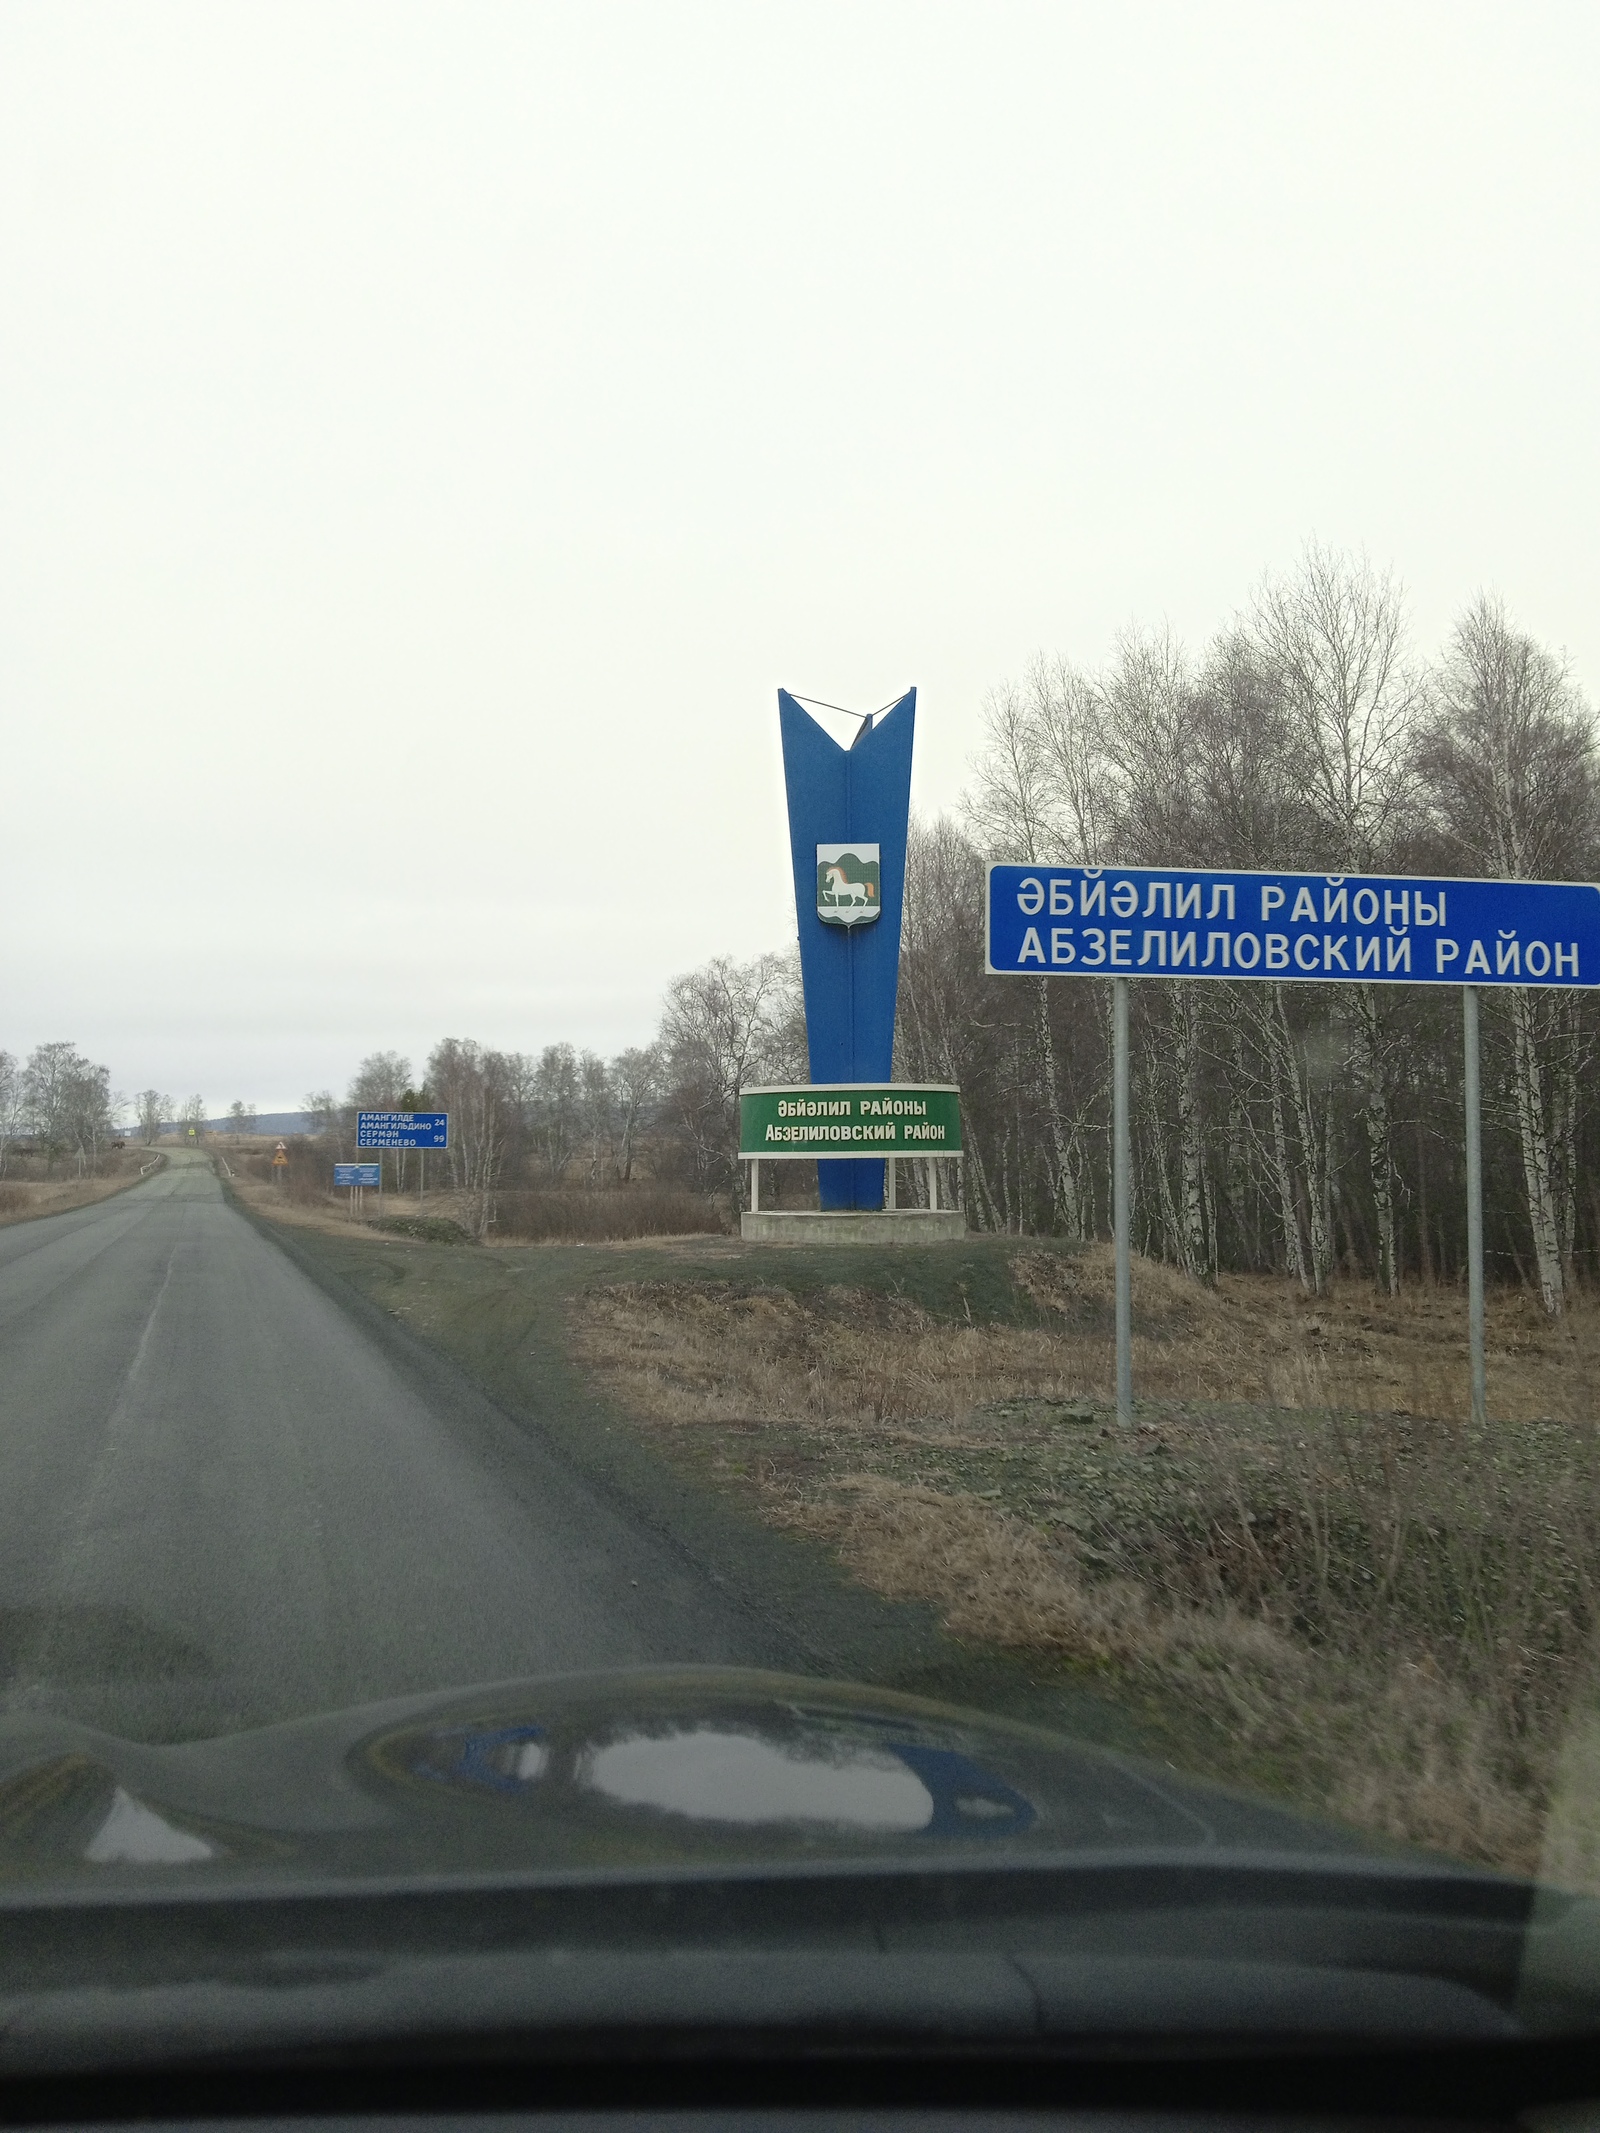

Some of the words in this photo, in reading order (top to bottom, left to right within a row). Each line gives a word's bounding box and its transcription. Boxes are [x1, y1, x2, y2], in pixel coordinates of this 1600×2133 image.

[1017, 869, 1235, 920] ӘБЙӘЛИЛ
[1261, 877, 1446, 927] РАЙОНЫ
[1017, 926, 1411, 972] АБЗЕЛИЛОВСКИЙ
[1436, 930, 1579, 977] РАЙОН
[778, 1098, 851, 1117] ӘБЙӘЛИЛ
[860, 1097, 926, 1116] РАЙОНЫ
[360, 1114, 414, 1122] АМАНГИЛДЕ
[360, 1122, 432, 1131] АМАНГИЛЬДИНО
[765, 1122, 896, 1141] АБЗЕЛИЛОВСКИЙ
[904, 1122, 945, 1140] РАЙОН
[360, 1138, 416, 1146] СЕРМЕНЕВО
[433, 1135, 445, 1143] 99
